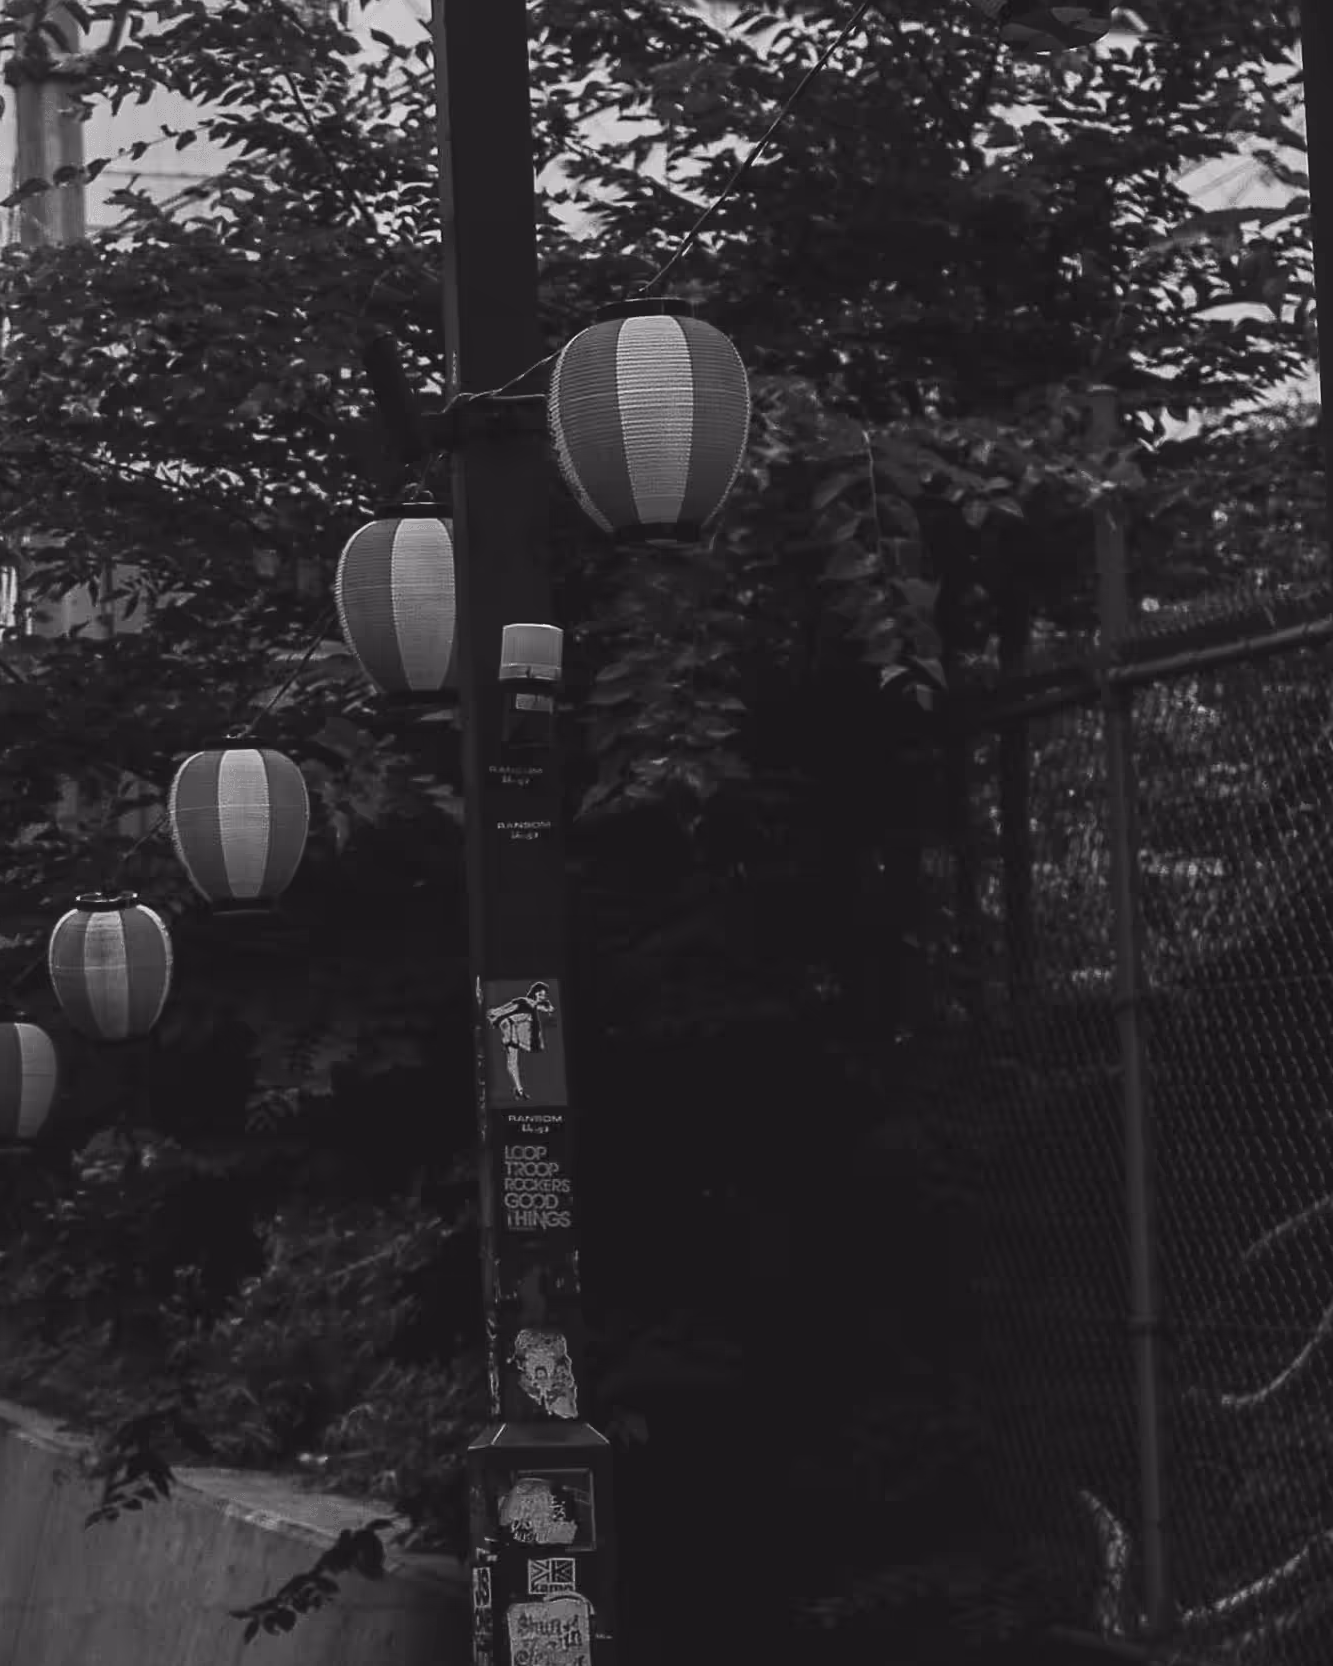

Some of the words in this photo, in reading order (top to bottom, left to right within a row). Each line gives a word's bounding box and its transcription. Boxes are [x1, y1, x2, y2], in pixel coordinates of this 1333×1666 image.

[504, 1145, 547, 1161] LOOP
[504, 1161, 559, 1177] TROOP
[504, 1178, 571, 1193] ROCKERS
[504, 1192, 559, 1210] GOOD
